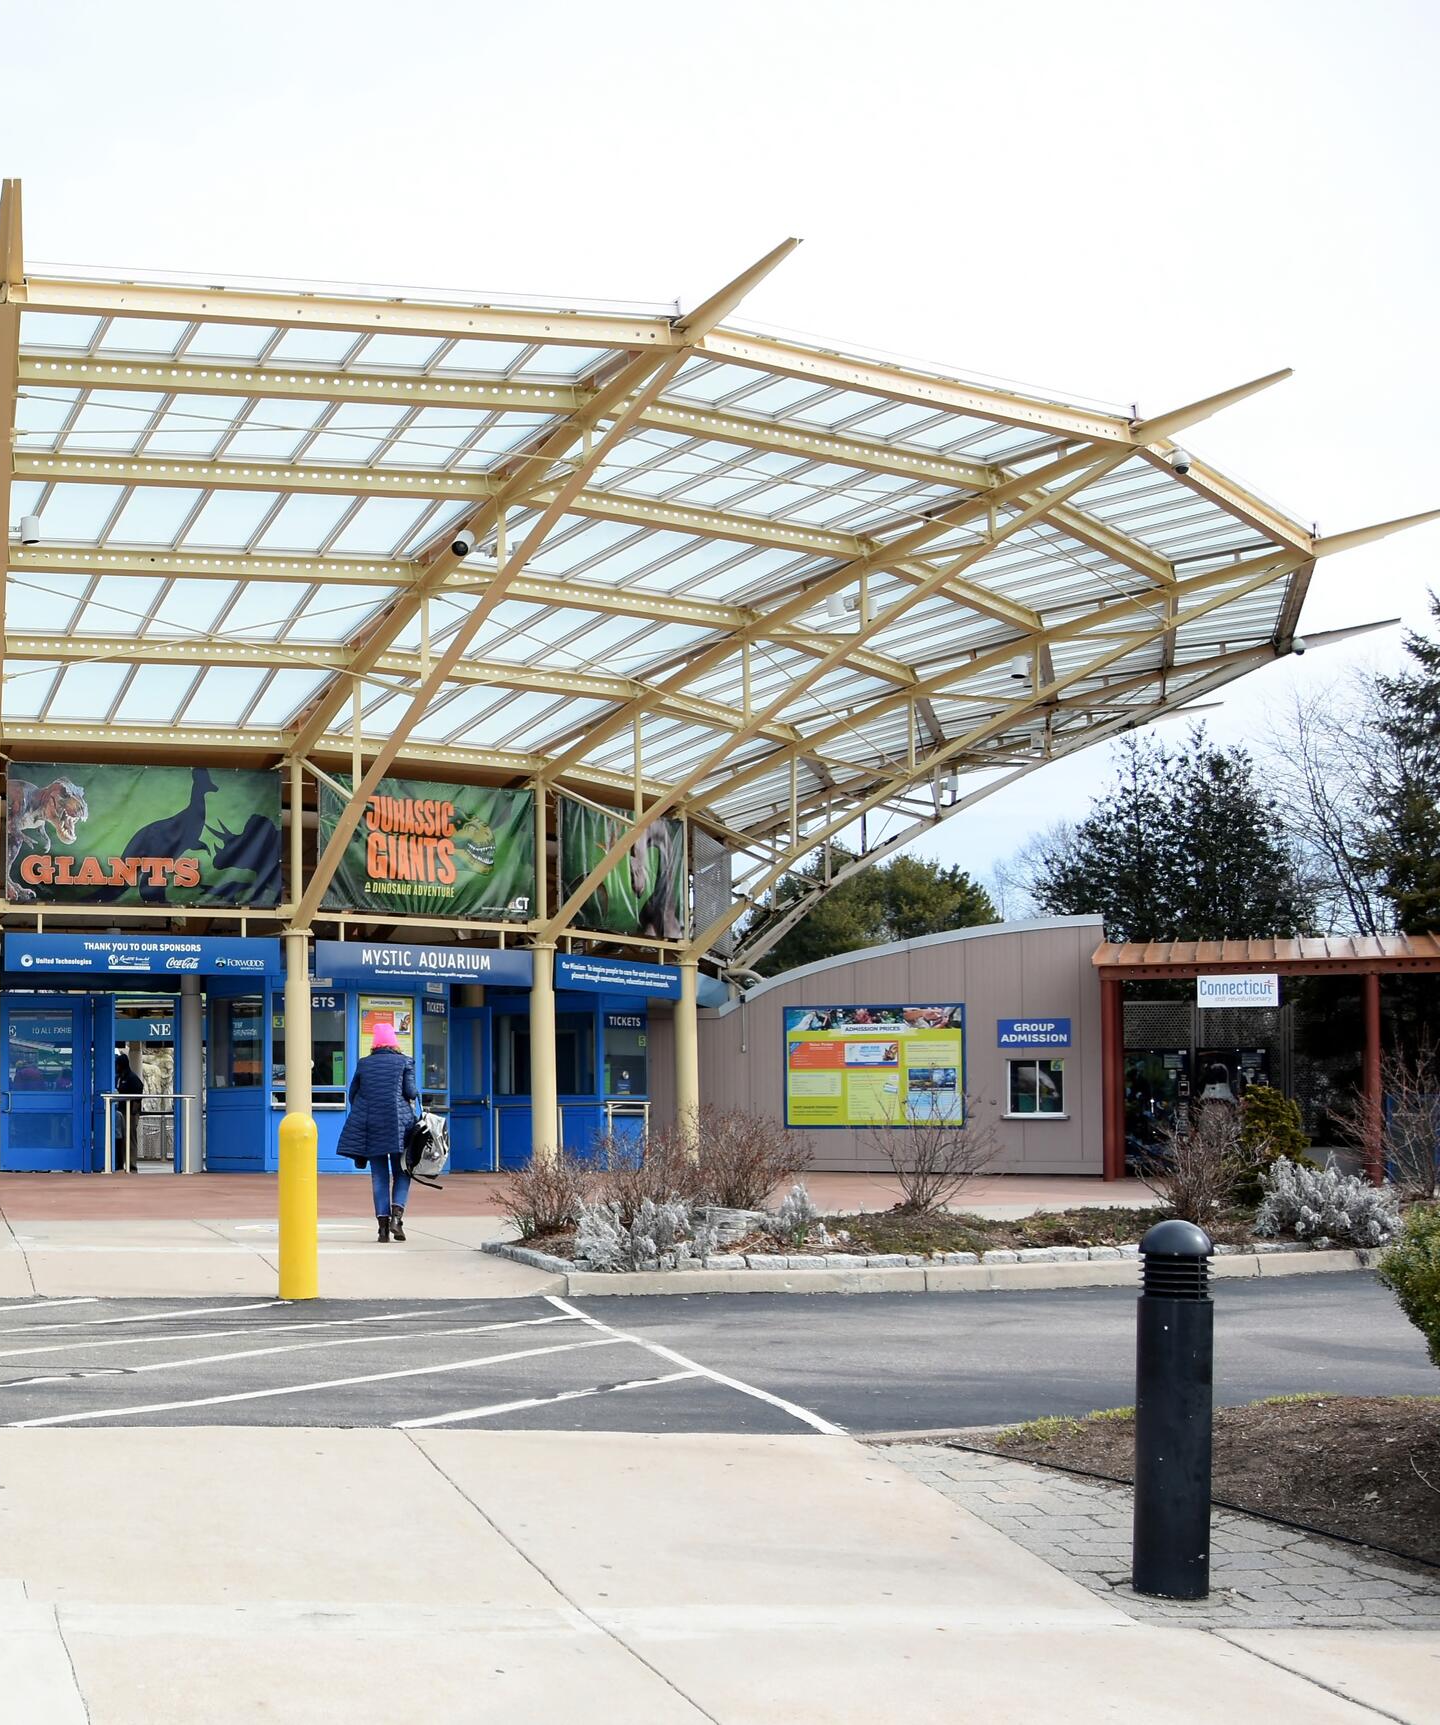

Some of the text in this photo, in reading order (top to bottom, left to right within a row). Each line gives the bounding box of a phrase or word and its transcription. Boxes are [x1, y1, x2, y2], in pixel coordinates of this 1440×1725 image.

[366, 795, 455, 837] JURASSIC
[367, 832, 457, 884] GIANTS
[20, 853, 201, 888] GIANTS
[372, 882, 411, 895] DINOSAUR
[413, 885, 455, 898] ADVENTURE
[84, 942, 201, 953] THANK YOU TO OUR SPONSORS
[55, 958, 92, 966] Technologies
[362, 949, 491, 970] MYSTIC AQUARIUM
[1200, 979, 1274, 996] Connecticut
[426, 1001, 445, 1013] TICKETS
[275, 1017, 283, 1026] 3
[609, 1016, 641, 1027] TICKETS
[1013, 1023, 1055, 1031] GROUP
[1001, 1034, 1067, 1042] ADMISSION
[1054, 1060, 1061, 1070] 6
